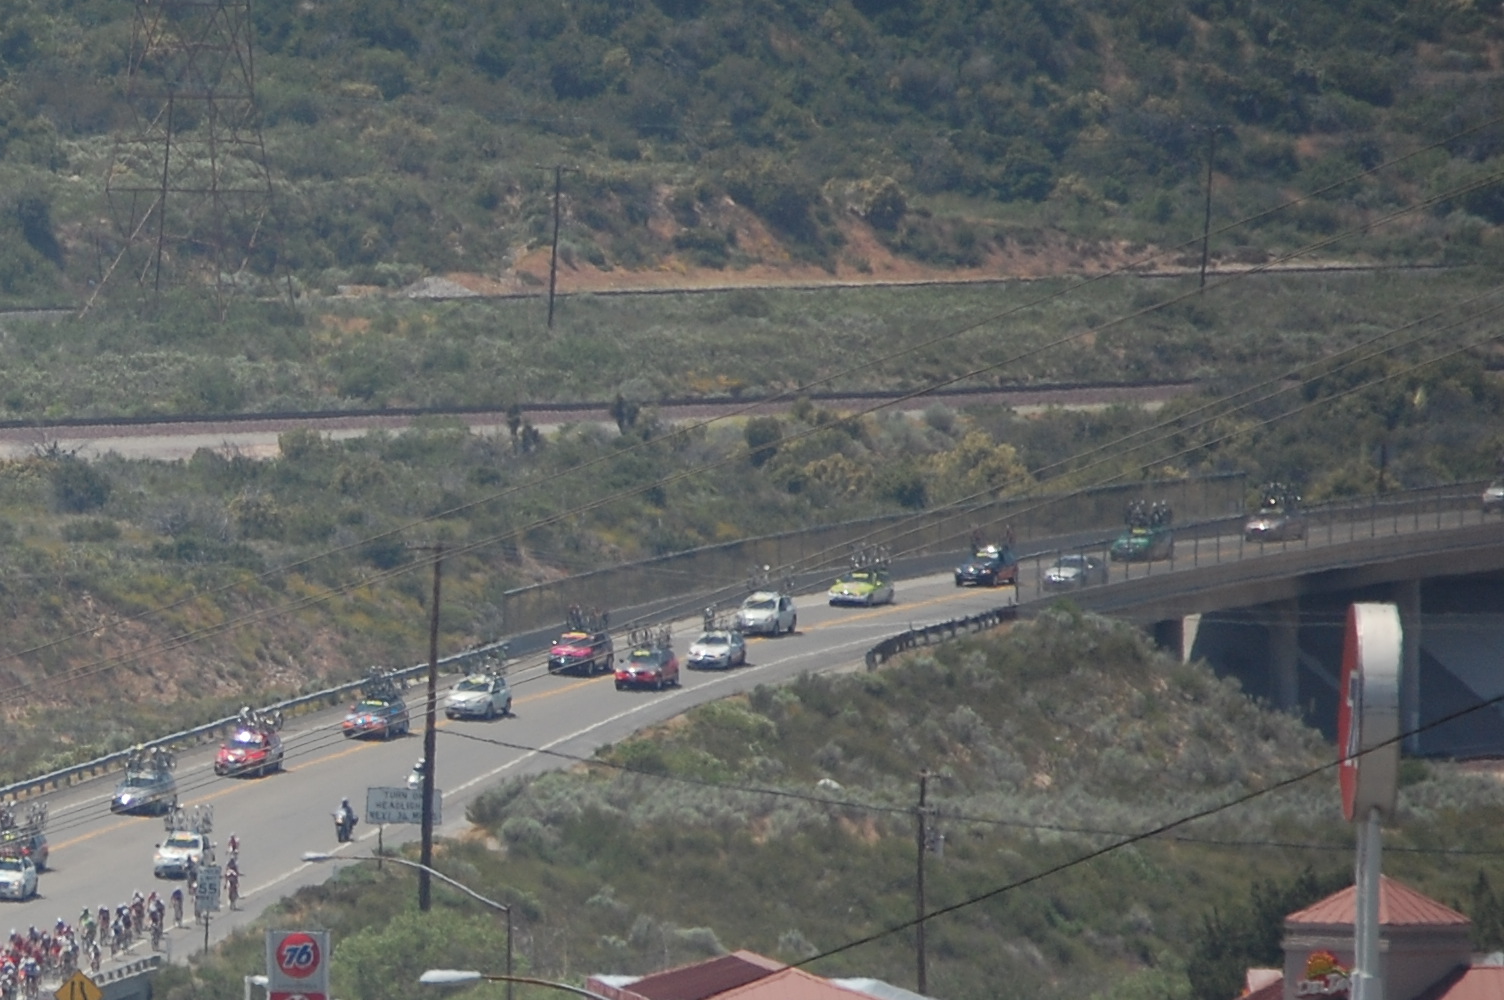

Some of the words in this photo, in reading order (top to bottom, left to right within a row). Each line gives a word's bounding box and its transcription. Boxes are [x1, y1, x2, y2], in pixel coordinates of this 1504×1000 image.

[376, 801, 423, 809] HEADLIGH
[198, 882, 217, 894] 55
[283, 943, 314, 969] 76
